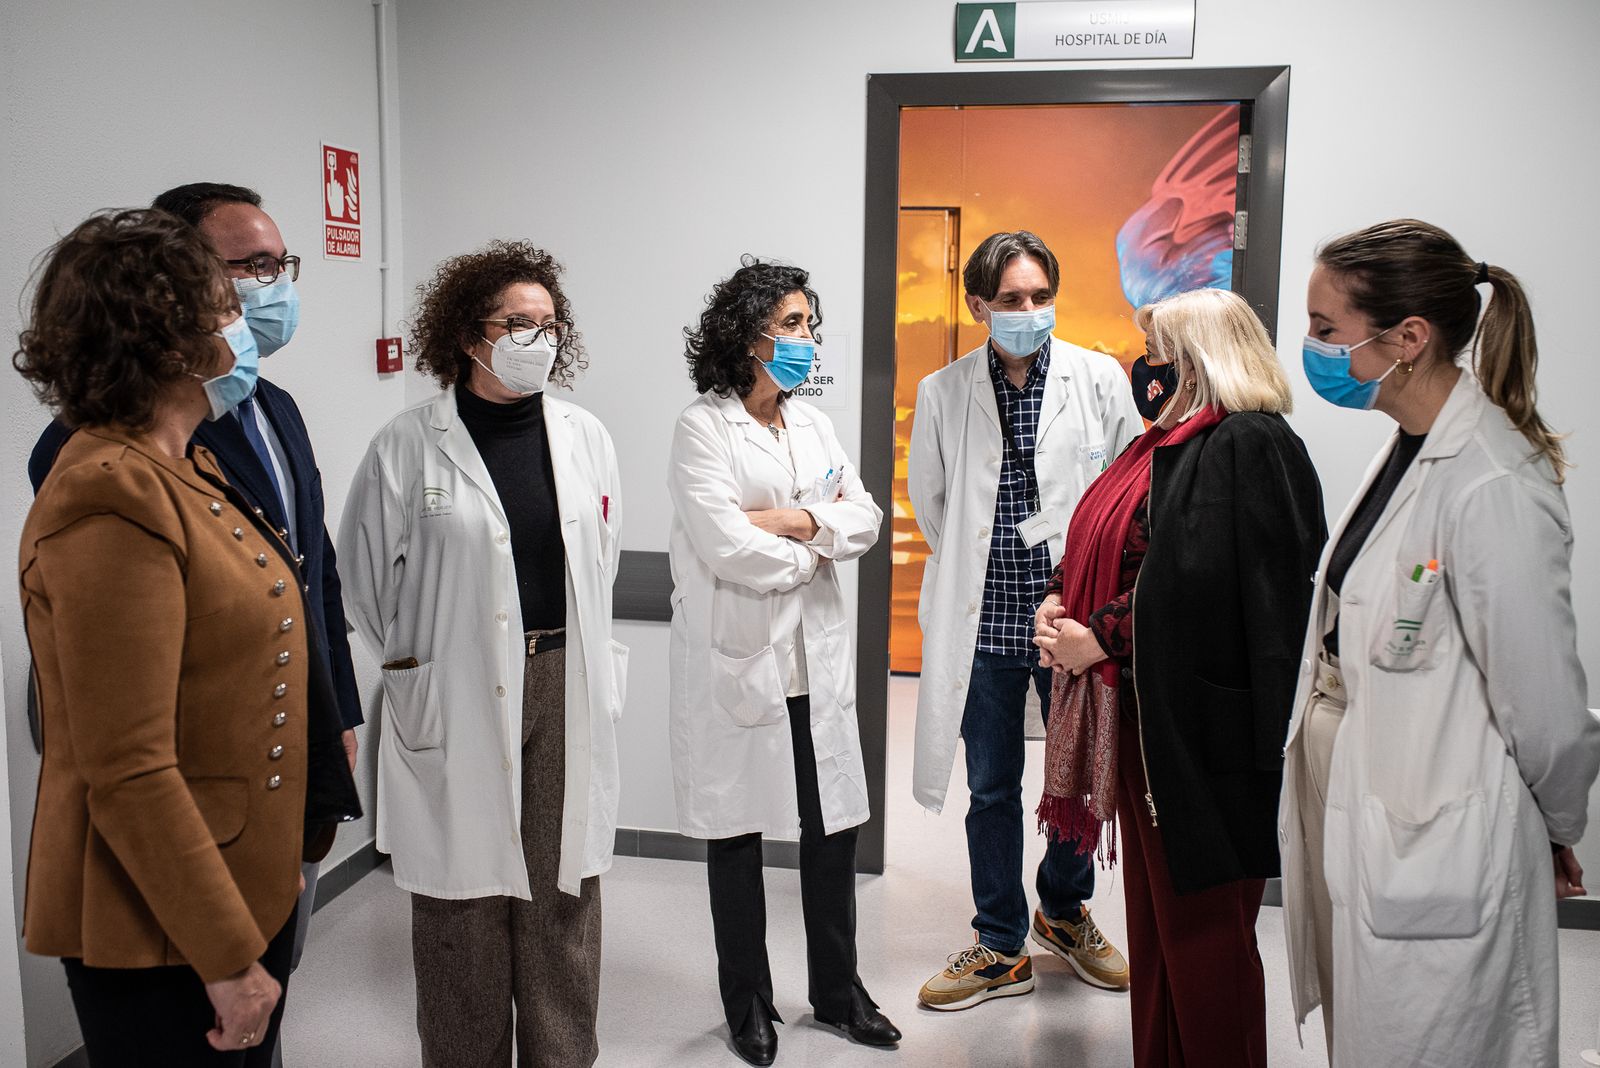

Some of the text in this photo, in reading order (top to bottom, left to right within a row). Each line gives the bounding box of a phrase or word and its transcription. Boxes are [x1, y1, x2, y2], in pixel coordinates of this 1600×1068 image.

[1055, 29, 1167, 46] HOSPITAL DE DÍA
[326, 227, 360, 242] PULSADOR
[327, 240, 360, 256] DE ALARMA
[814, 364, 821, 372] Y
[813, 376, 834, 384] SER
[792, 388, 823, 396] NDIDO
